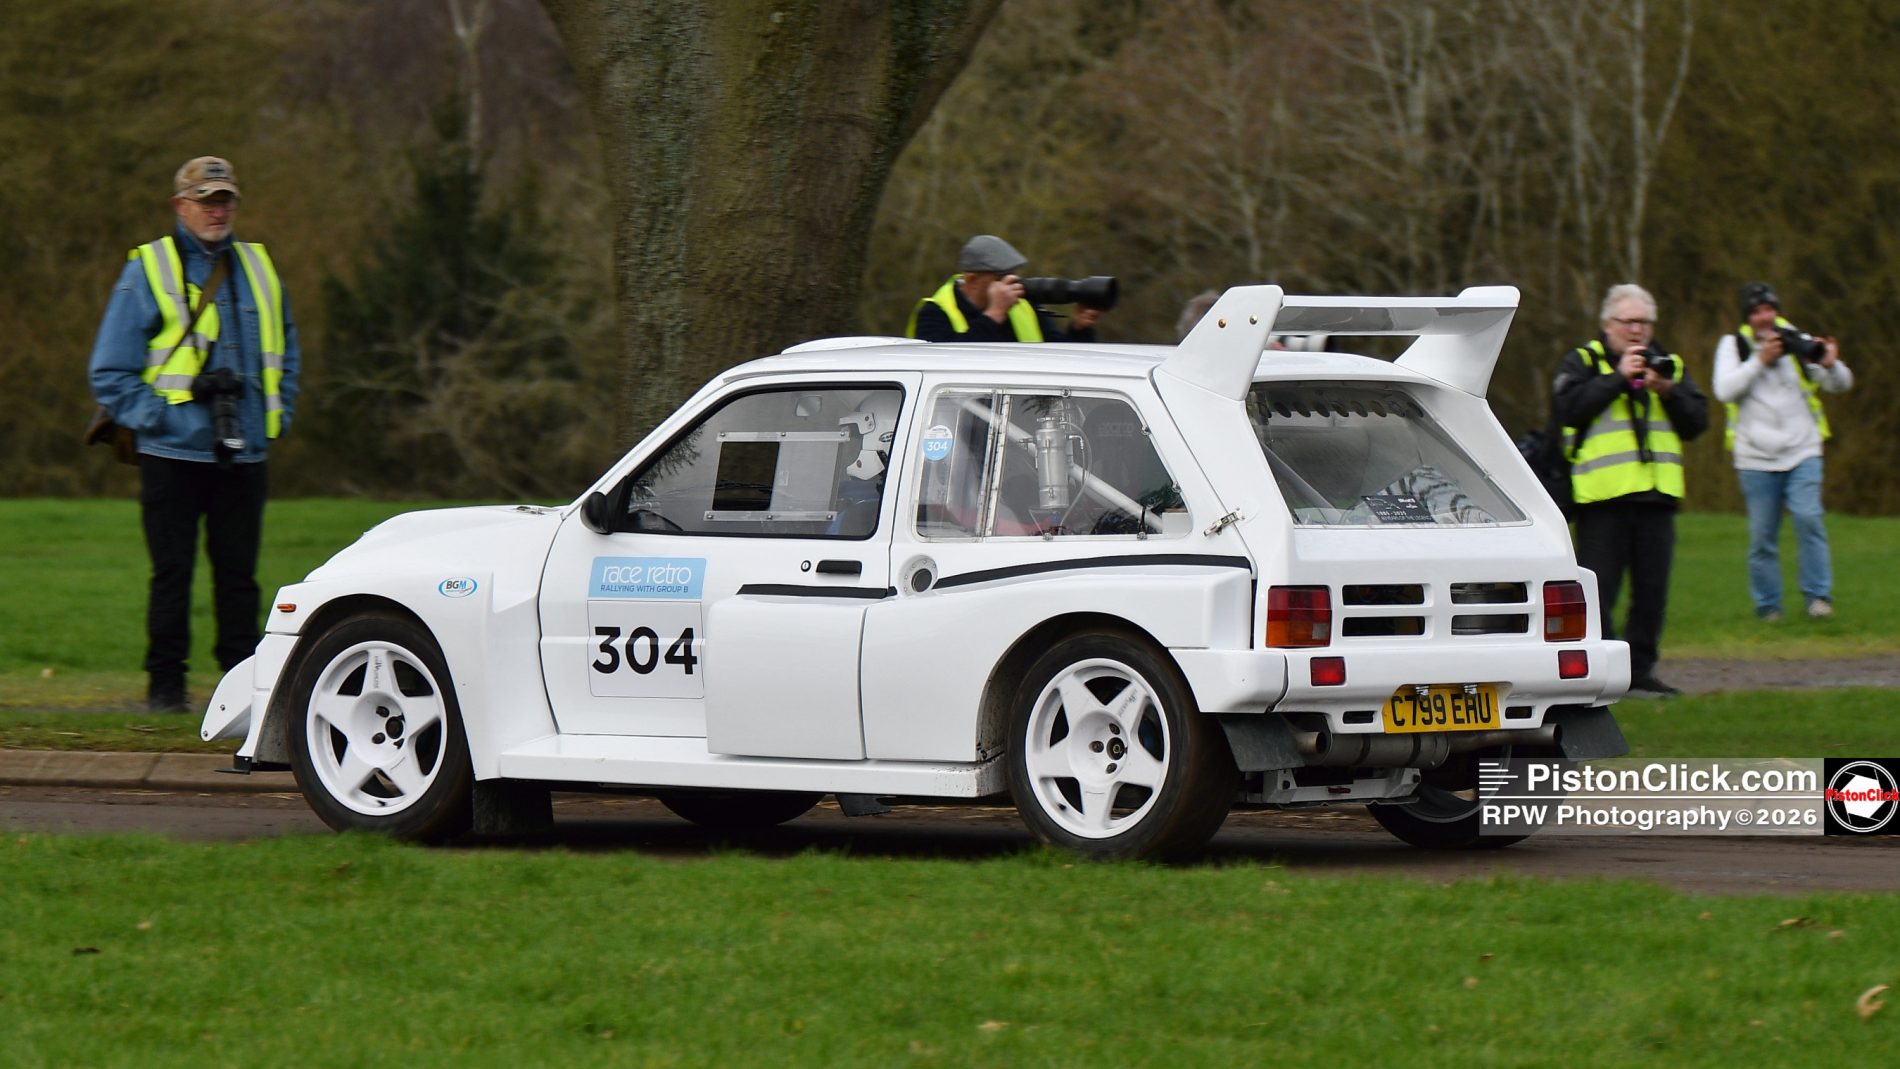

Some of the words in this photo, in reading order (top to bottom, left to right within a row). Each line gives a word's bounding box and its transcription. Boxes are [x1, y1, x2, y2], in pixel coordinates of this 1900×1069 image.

[927, 441, 948, 451] 304
[602, 565, 643, 583] race
[646, 562, 692, 584] retro
[446, 580, 467, 589] BGM
[656, 585, 682, 593] GROUP
[592, 626, 698, 675] 304
[1391, 694, 1446, 726] C799
